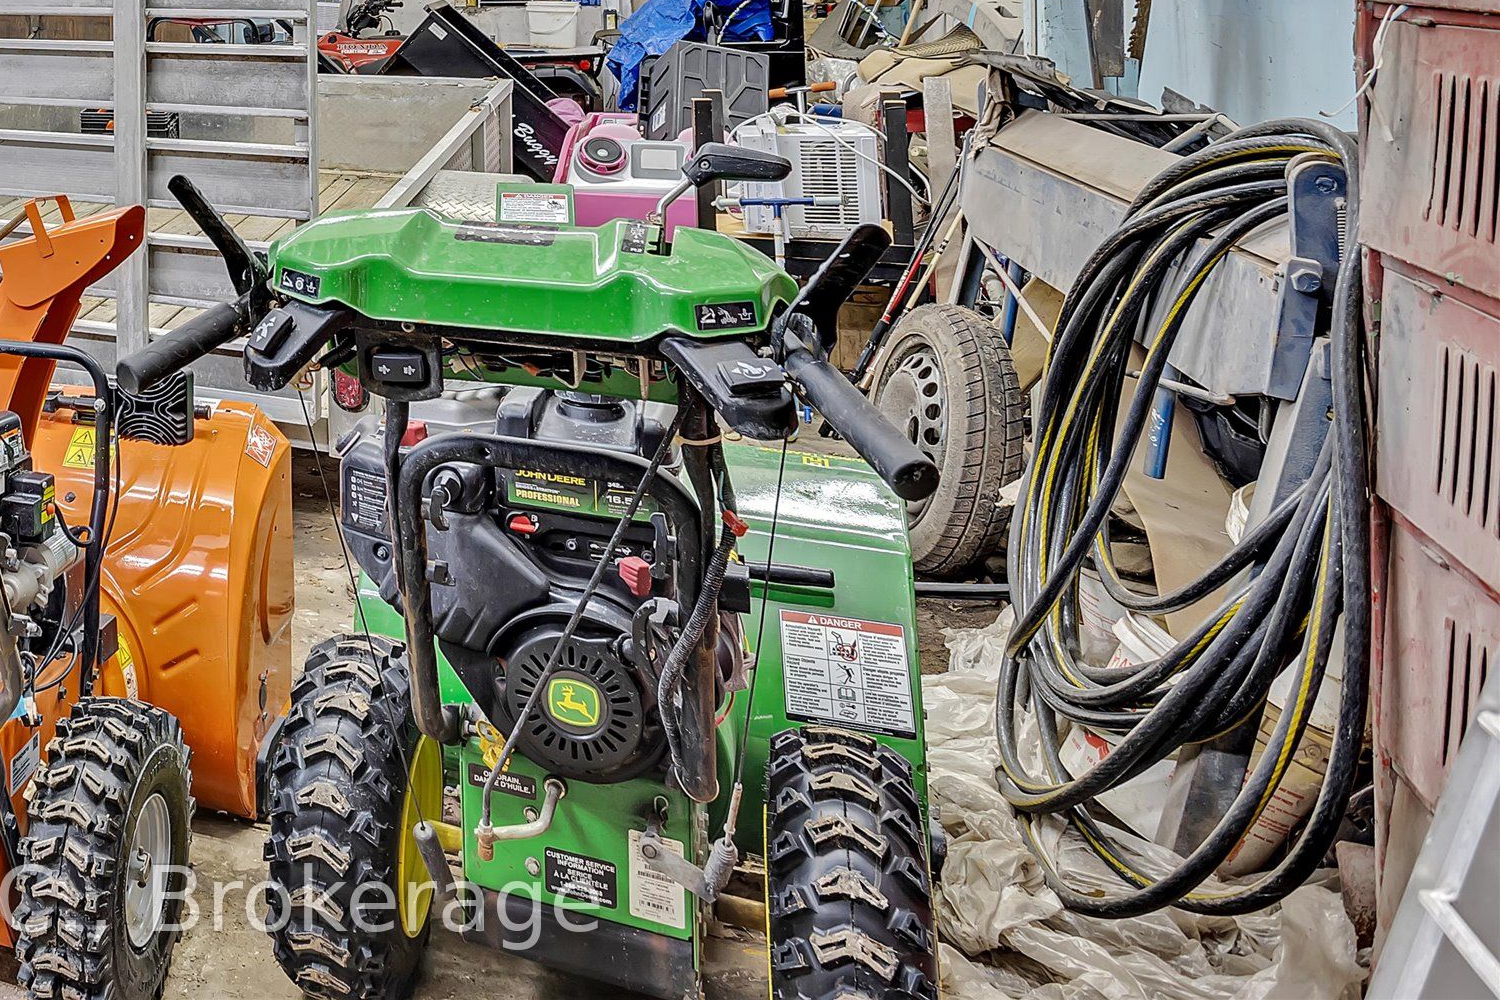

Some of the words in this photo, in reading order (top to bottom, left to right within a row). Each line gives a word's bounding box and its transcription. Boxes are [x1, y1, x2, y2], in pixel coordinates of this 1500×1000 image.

[337, 43, 388, 51] HONDA
[513, 122, 559, 165] Buggy
[515, 469, 547, 481] JOHN
[547, 474, 586, 486] DEERE
[516, 489, 581, 506] PROFESSIONAL
[819, 617, 862, 630] DANGER
[546, 850, 584, 866] CUSTOMER
[585, 860, 615, 873] SERVICE
[557, 858, 604, 877] INFORMATION
[570, 874, 609, 891] CLIENTÈLE
